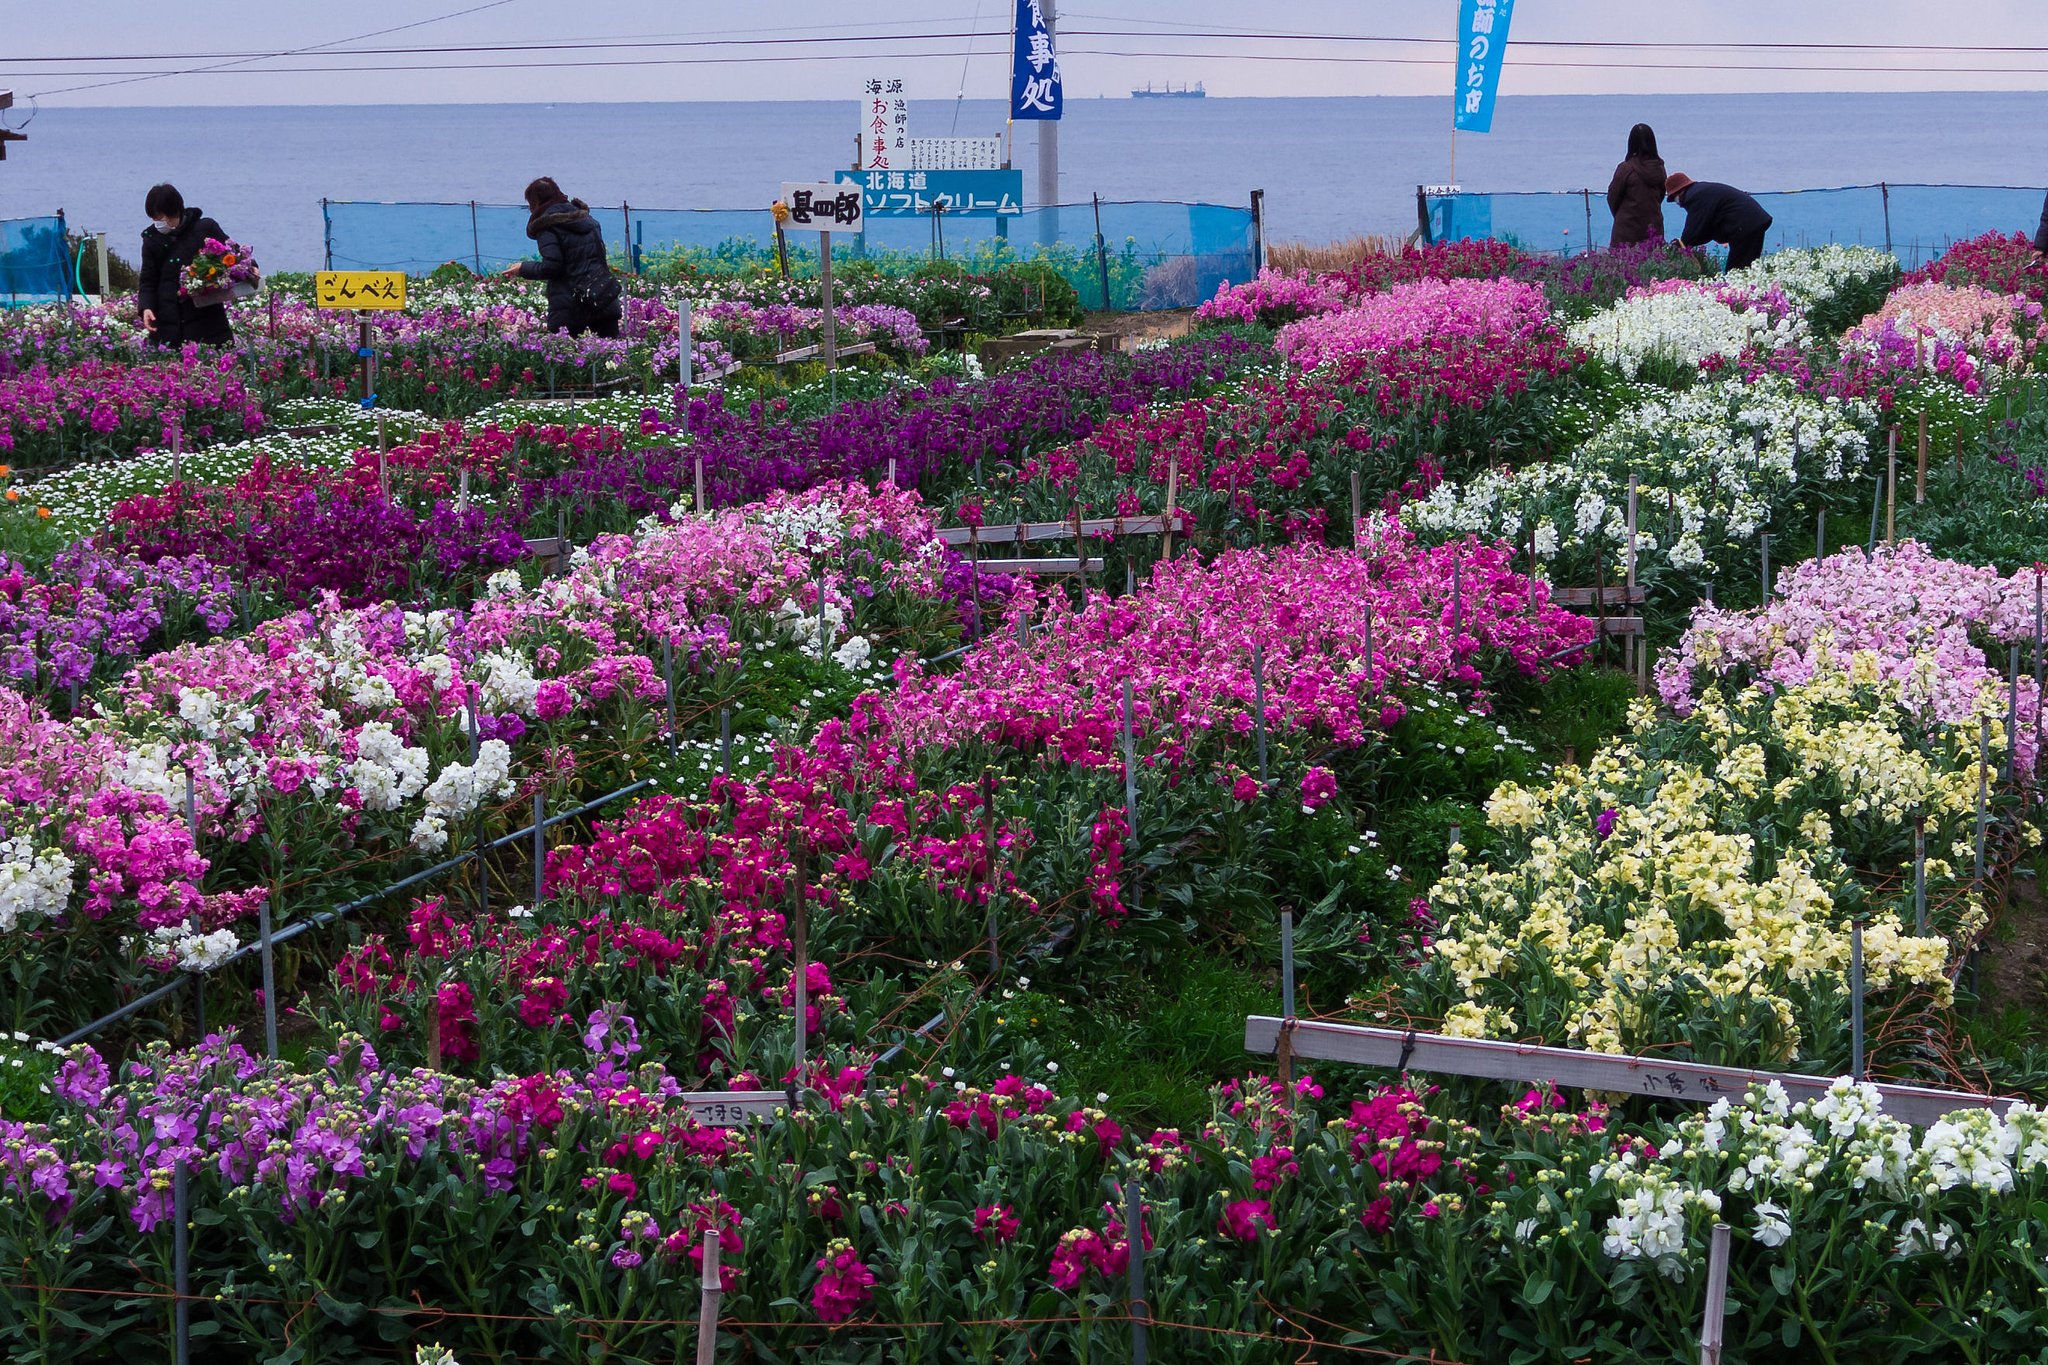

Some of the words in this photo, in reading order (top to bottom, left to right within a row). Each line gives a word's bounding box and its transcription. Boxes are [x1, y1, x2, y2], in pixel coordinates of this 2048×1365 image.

[868, 97, 889, 170] お食事処
[893, 99, 907, 149] 漁師の店
[866, 171, 927, 190] 北海道
[791, 190, 861, 225] 甚四郎
[866, 191, 1020, 215] ソフトクリーム
[323, 274, 400, 302] ごんべえ
